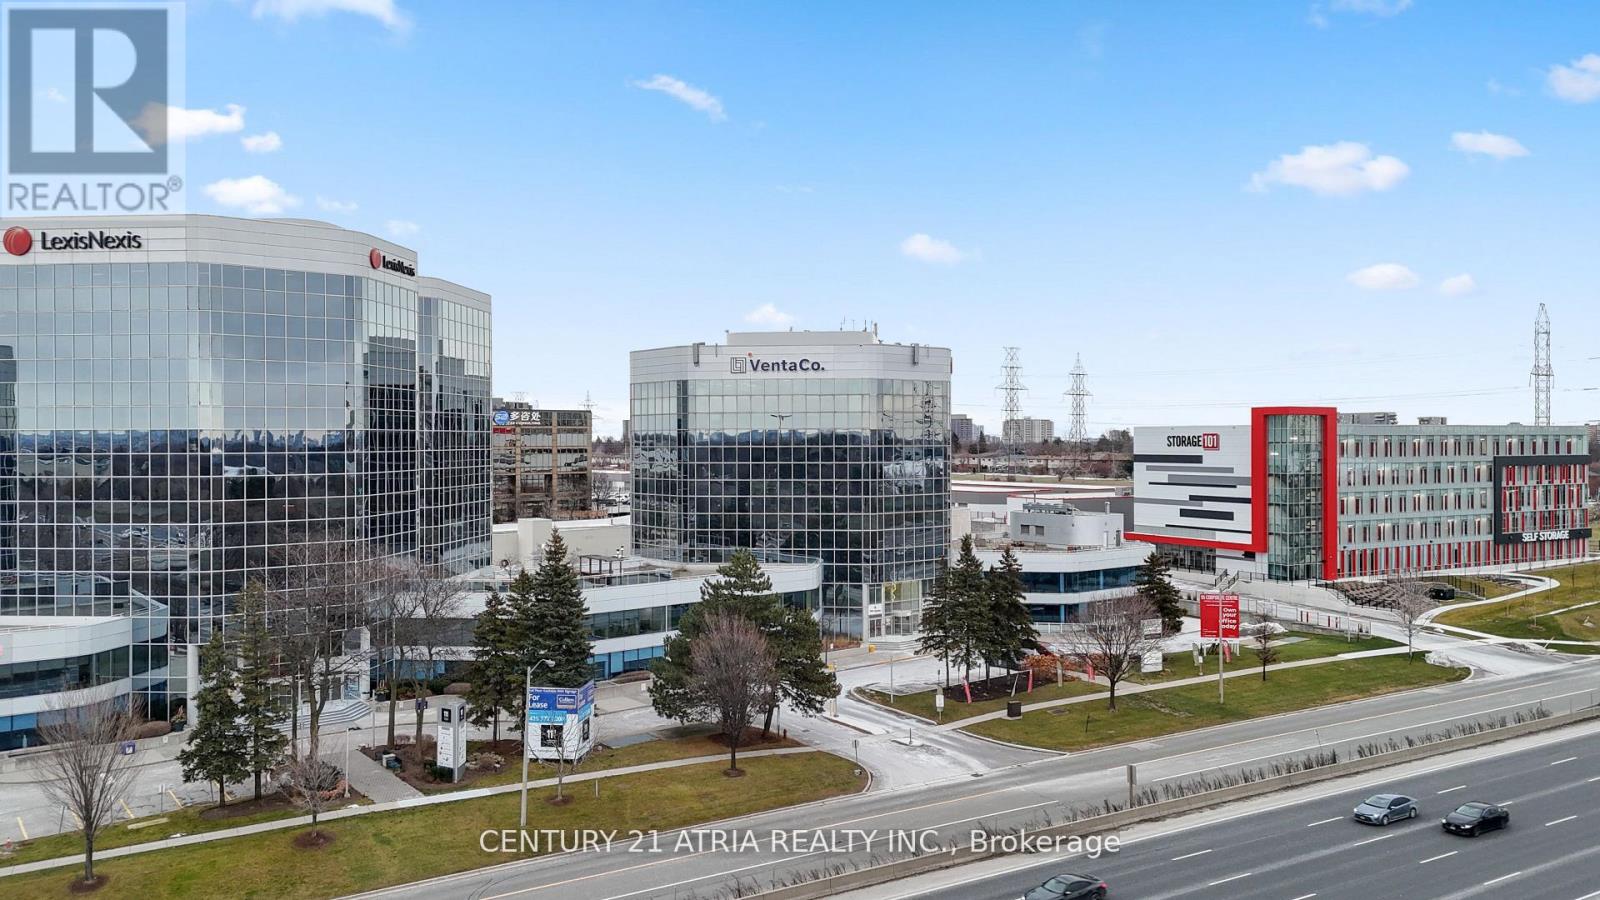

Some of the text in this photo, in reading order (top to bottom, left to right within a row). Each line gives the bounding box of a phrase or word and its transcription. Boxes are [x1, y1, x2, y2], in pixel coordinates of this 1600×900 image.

[40, 230, 143, 251] LexisNexis
[1522, 530, 1569, 542] SELF STORAGE
[529, 693, 541, 701] For
